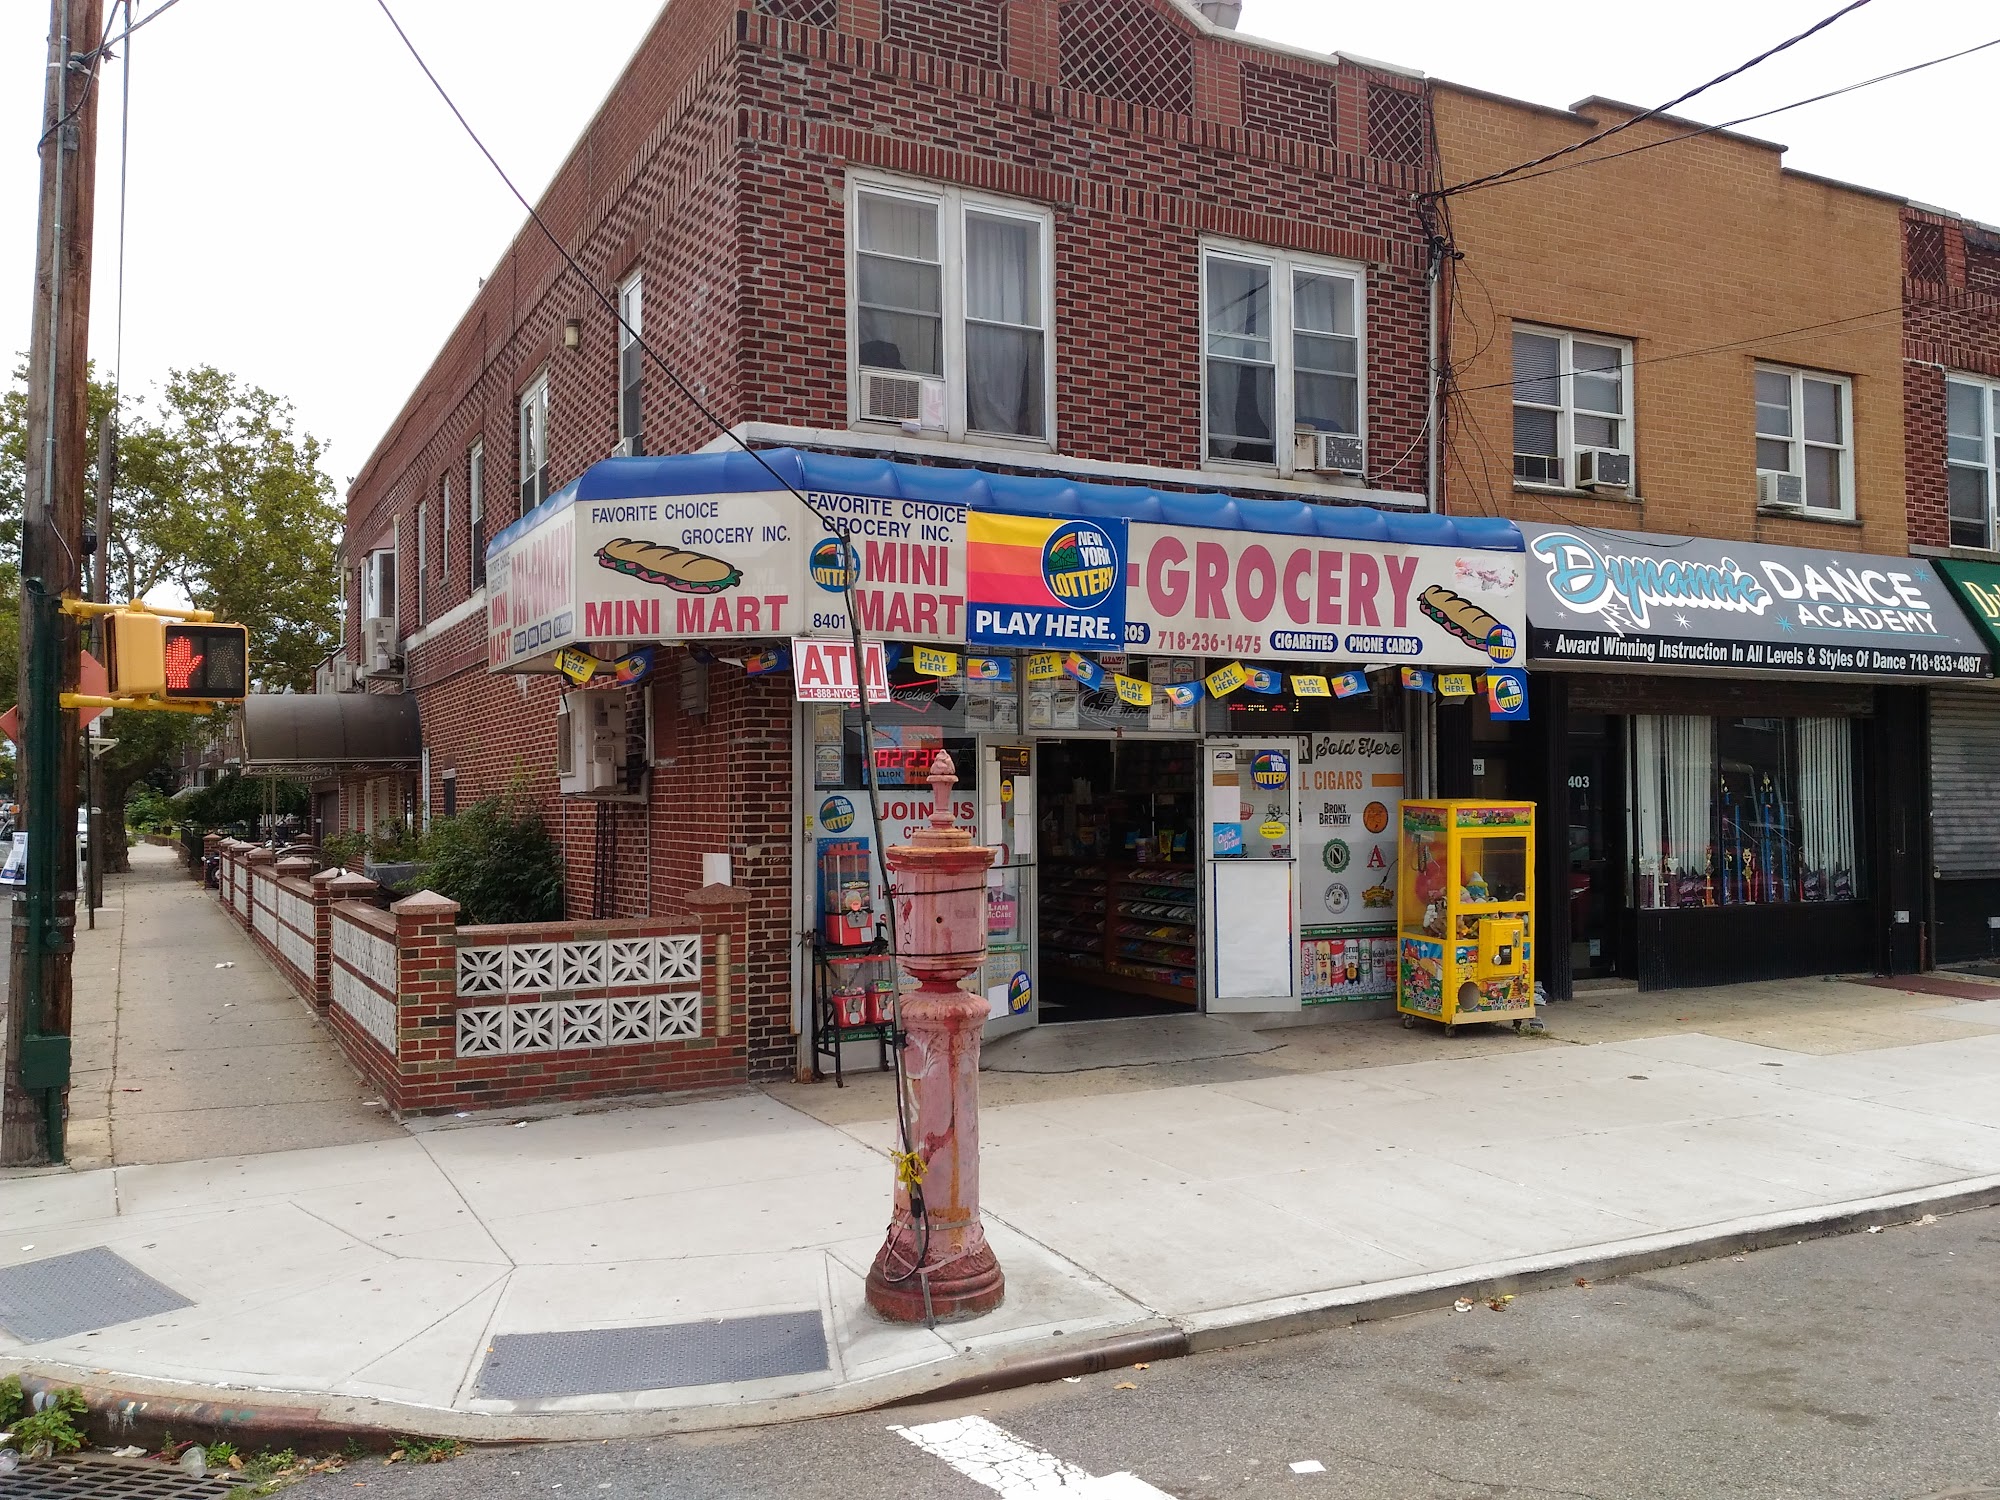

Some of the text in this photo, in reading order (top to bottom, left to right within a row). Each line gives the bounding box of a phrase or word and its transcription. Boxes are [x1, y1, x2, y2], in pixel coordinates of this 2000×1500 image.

[592, 502, 718, 523] FAVORITE CHOICE
[808, 493, 966, 523] FAVORITE CHOICE
[682, 525, 790, 545] GROCERY INC.
[822, 515, 953, 542] GROCERY INC.
[1078, 531, 1103, 546] NEW
[866, 540, 948, 586] MINI
[1080, 547, 1111, 567] YORK
[1050, 567, 1113, 597] LOTTERY
[1531, 532, 1773, 629] Dynamic
[1760, 560, 1931, 609] DANCE
[492, 591, 508, 629] MINI
[585, 595, 788, 636] MINI MART
[856, 590, 963, 634] MART
[1798, 603, 1938, 633] ACADEMY
[813, 613, 846, 629] 8401
[976, 610, 1116, 640] PLAY HERE.
[490, 628, 511, 667] MART
[1158, 631, 1261, 653] 718-236-1475
[1275, 633, 1334, 650] CIGARETTES
[1350, 636, 1418, 654] PHONE CARDS
[920, 652, 946, 663] PLAY
[1029, 655, 1052, 667] PLAY
[1488, 645, 1515, 659] LOTTERY
[1555, 634, 1600, 655] Award
[1603, 637, 1656, 662] Winning
[1659, 640, 1730, 662] Instruction
[1732, 643, 1744, 661] In
[1747, 645, 1763, 663] All
[1767, 645, 1804, 664] Levels
[1807, 647, 1816, 665] &
[1819, 648, 1854, 671] Styles
[1856, 650, 1870, 668] Of
[1873, 652, 1907, 670] Dance
[802, 645, 882, 686] ATM
[1029, 664, 1057, 675] HERE.
[1212, 668, 1233, 685] PLAY
[1215, 676, 1242, 693] HERE.
[1297, 678, 1318, 686] PLAY
[1444, 677, 1463, 685] PLAY
[809, 688, 878, 699] 1-888-NYCE-TM
[1120, 680, 1142, 692] PLAY
[1316, 737, 1356, 759] Sold
[1358, 737, 1401, 757] Here
[1271, 762, 1287, 772] YORK
[1254, 772, 1287, 784] LOTTERY
[1314, 771, 1362, 790] CIGARS
[1568, 776, 1589, 788] 403
[881, 802, 934, 820] JOIN
[1324, 803, 1346, 814] BRONX
[823, 813, 853, 830] LOTTERY
[1319, 813, 1351, 825] BREWERY
[988, 903, 1008, 911] LIAM
